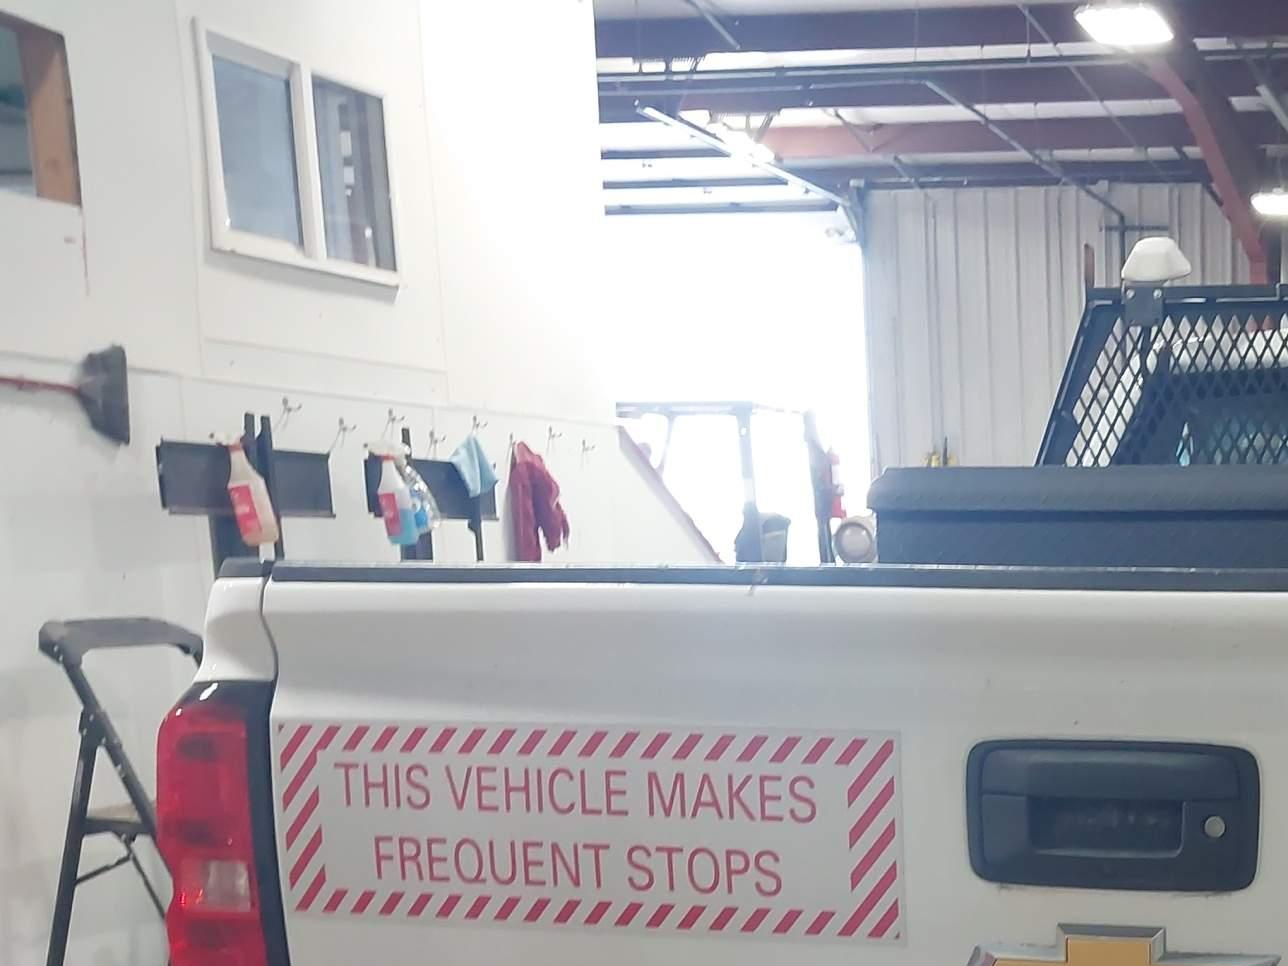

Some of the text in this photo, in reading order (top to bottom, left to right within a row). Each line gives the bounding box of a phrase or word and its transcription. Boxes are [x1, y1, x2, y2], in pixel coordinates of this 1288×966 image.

[333, 762, 817, 824] THIS VEHICLE MAKES
[373, 835, 782, 897] FREQUENT STOPS
